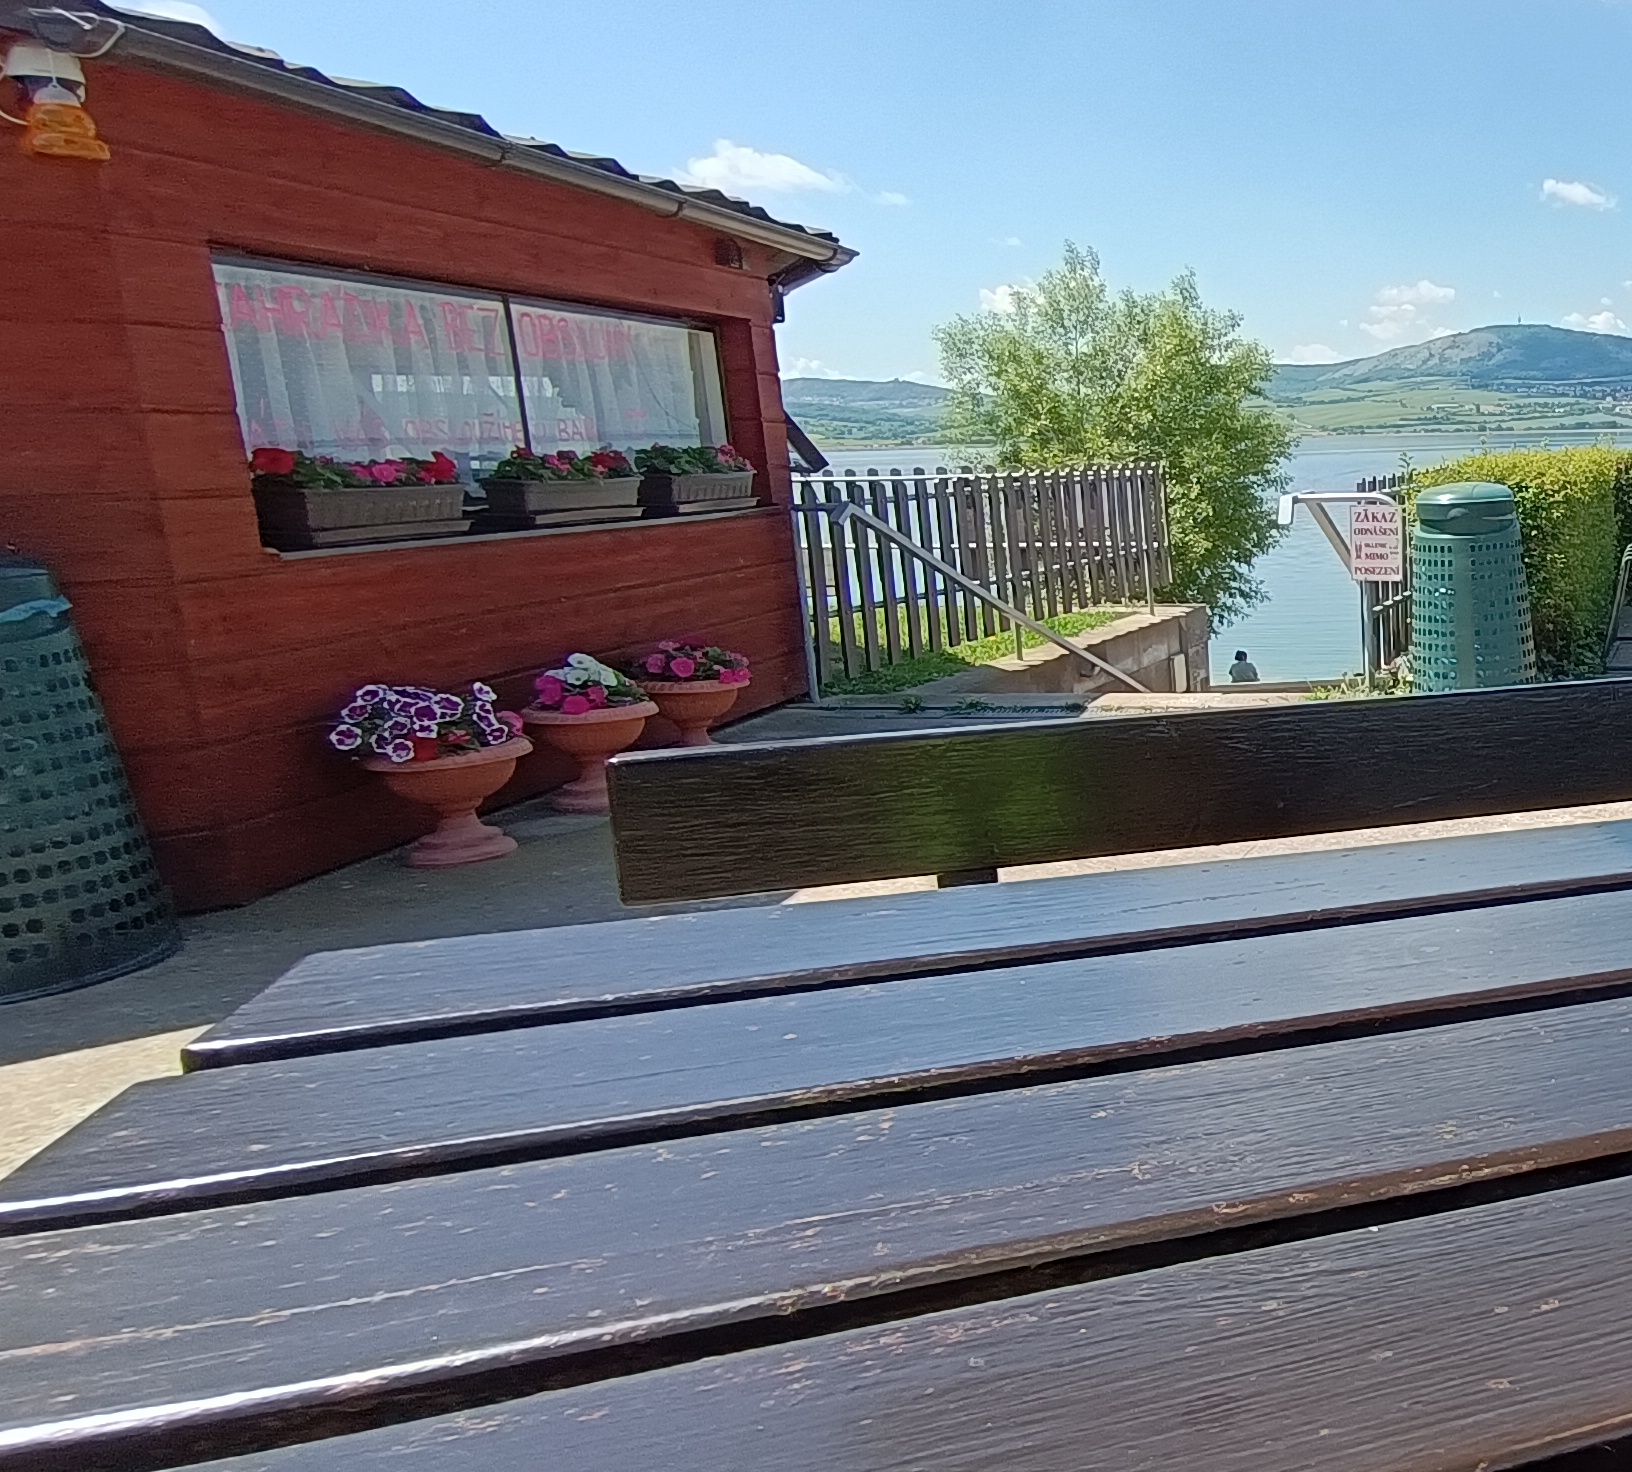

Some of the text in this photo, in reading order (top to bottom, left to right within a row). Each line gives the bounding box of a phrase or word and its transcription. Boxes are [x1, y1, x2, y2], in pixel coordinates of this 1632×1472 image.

[437, 301, 505, 357] BEZ
[1353, 508, 1398, 524] ZÁKAZ
[1364, 552, 1389, 561] MIMO
